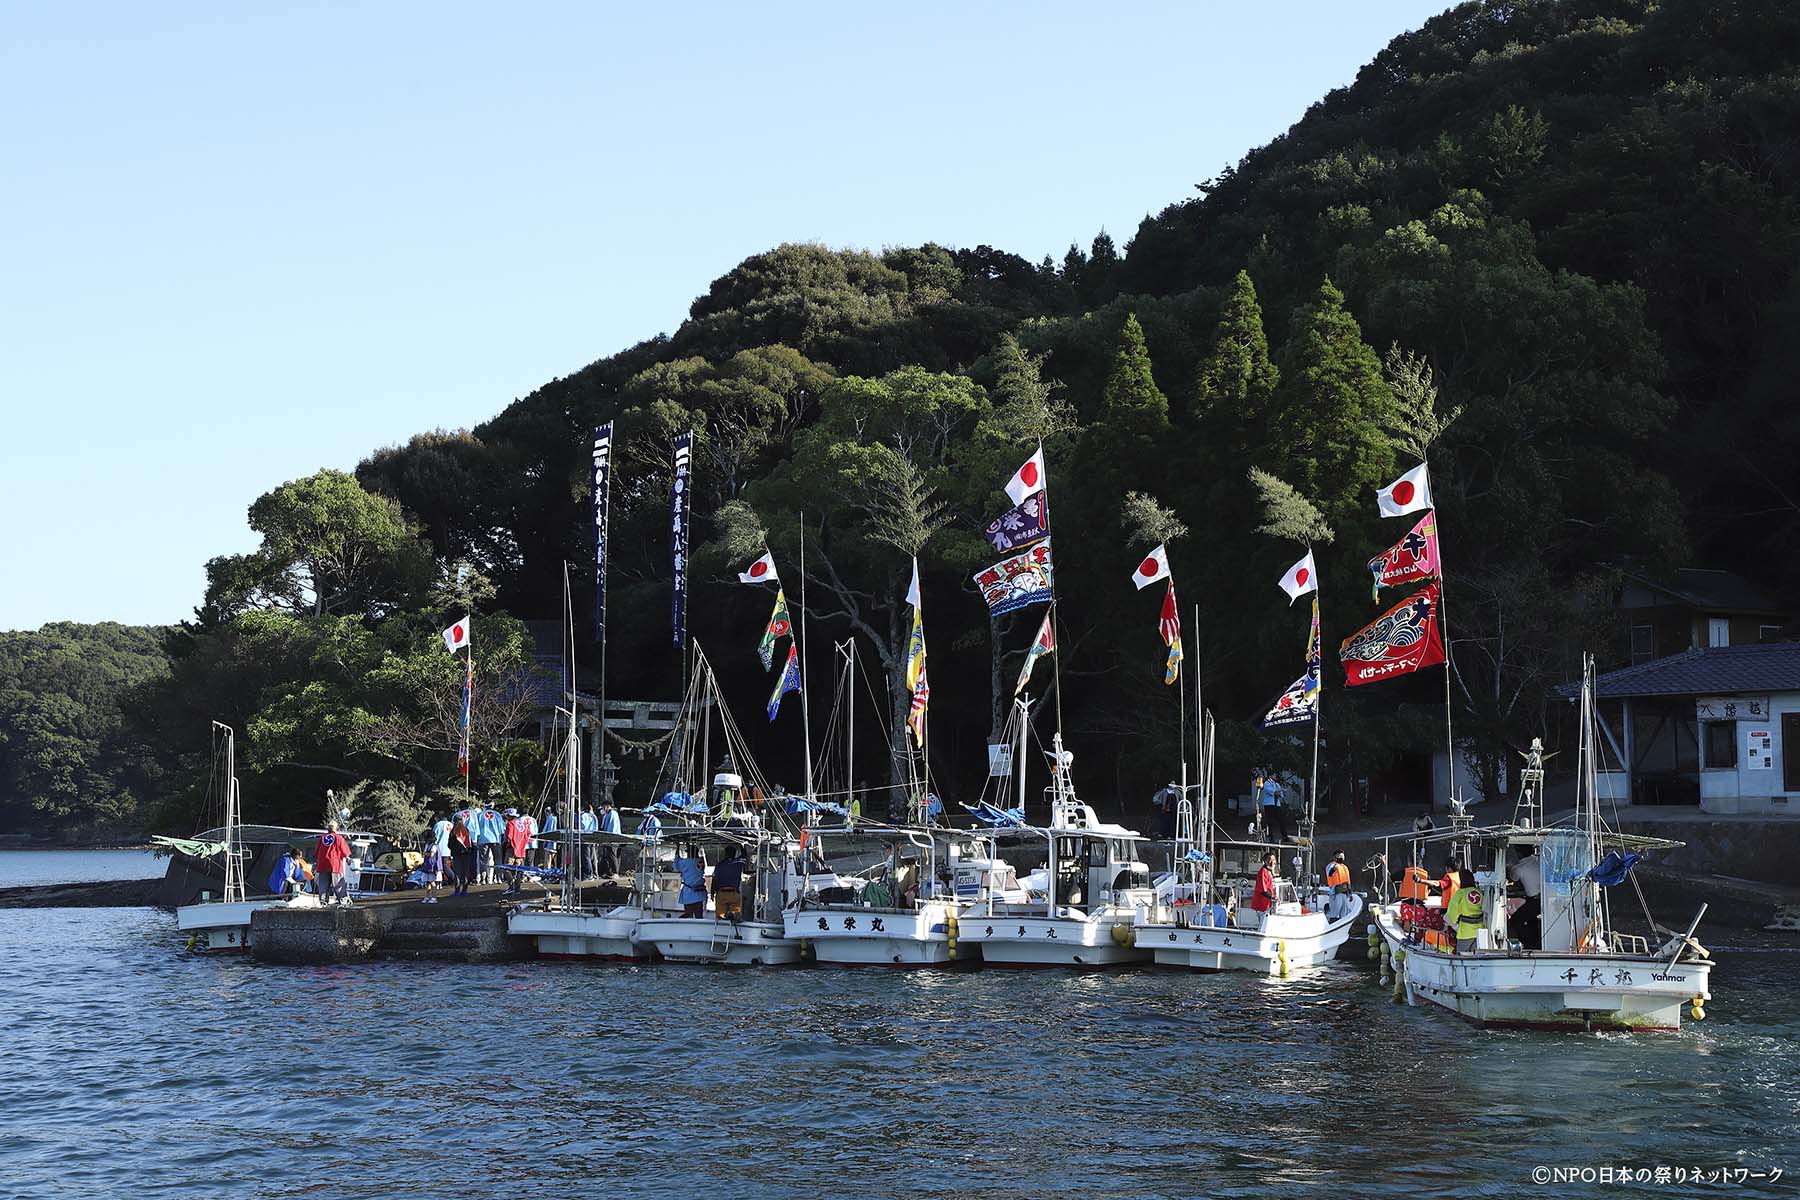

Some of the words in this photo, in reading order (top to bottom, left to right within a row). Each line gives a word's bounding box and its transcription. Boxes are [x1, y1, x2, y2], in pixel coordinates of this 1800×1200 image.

[817, 917, 884, 931] 亀栄丸
[1651, 973, 1687, 982] Yanmar
